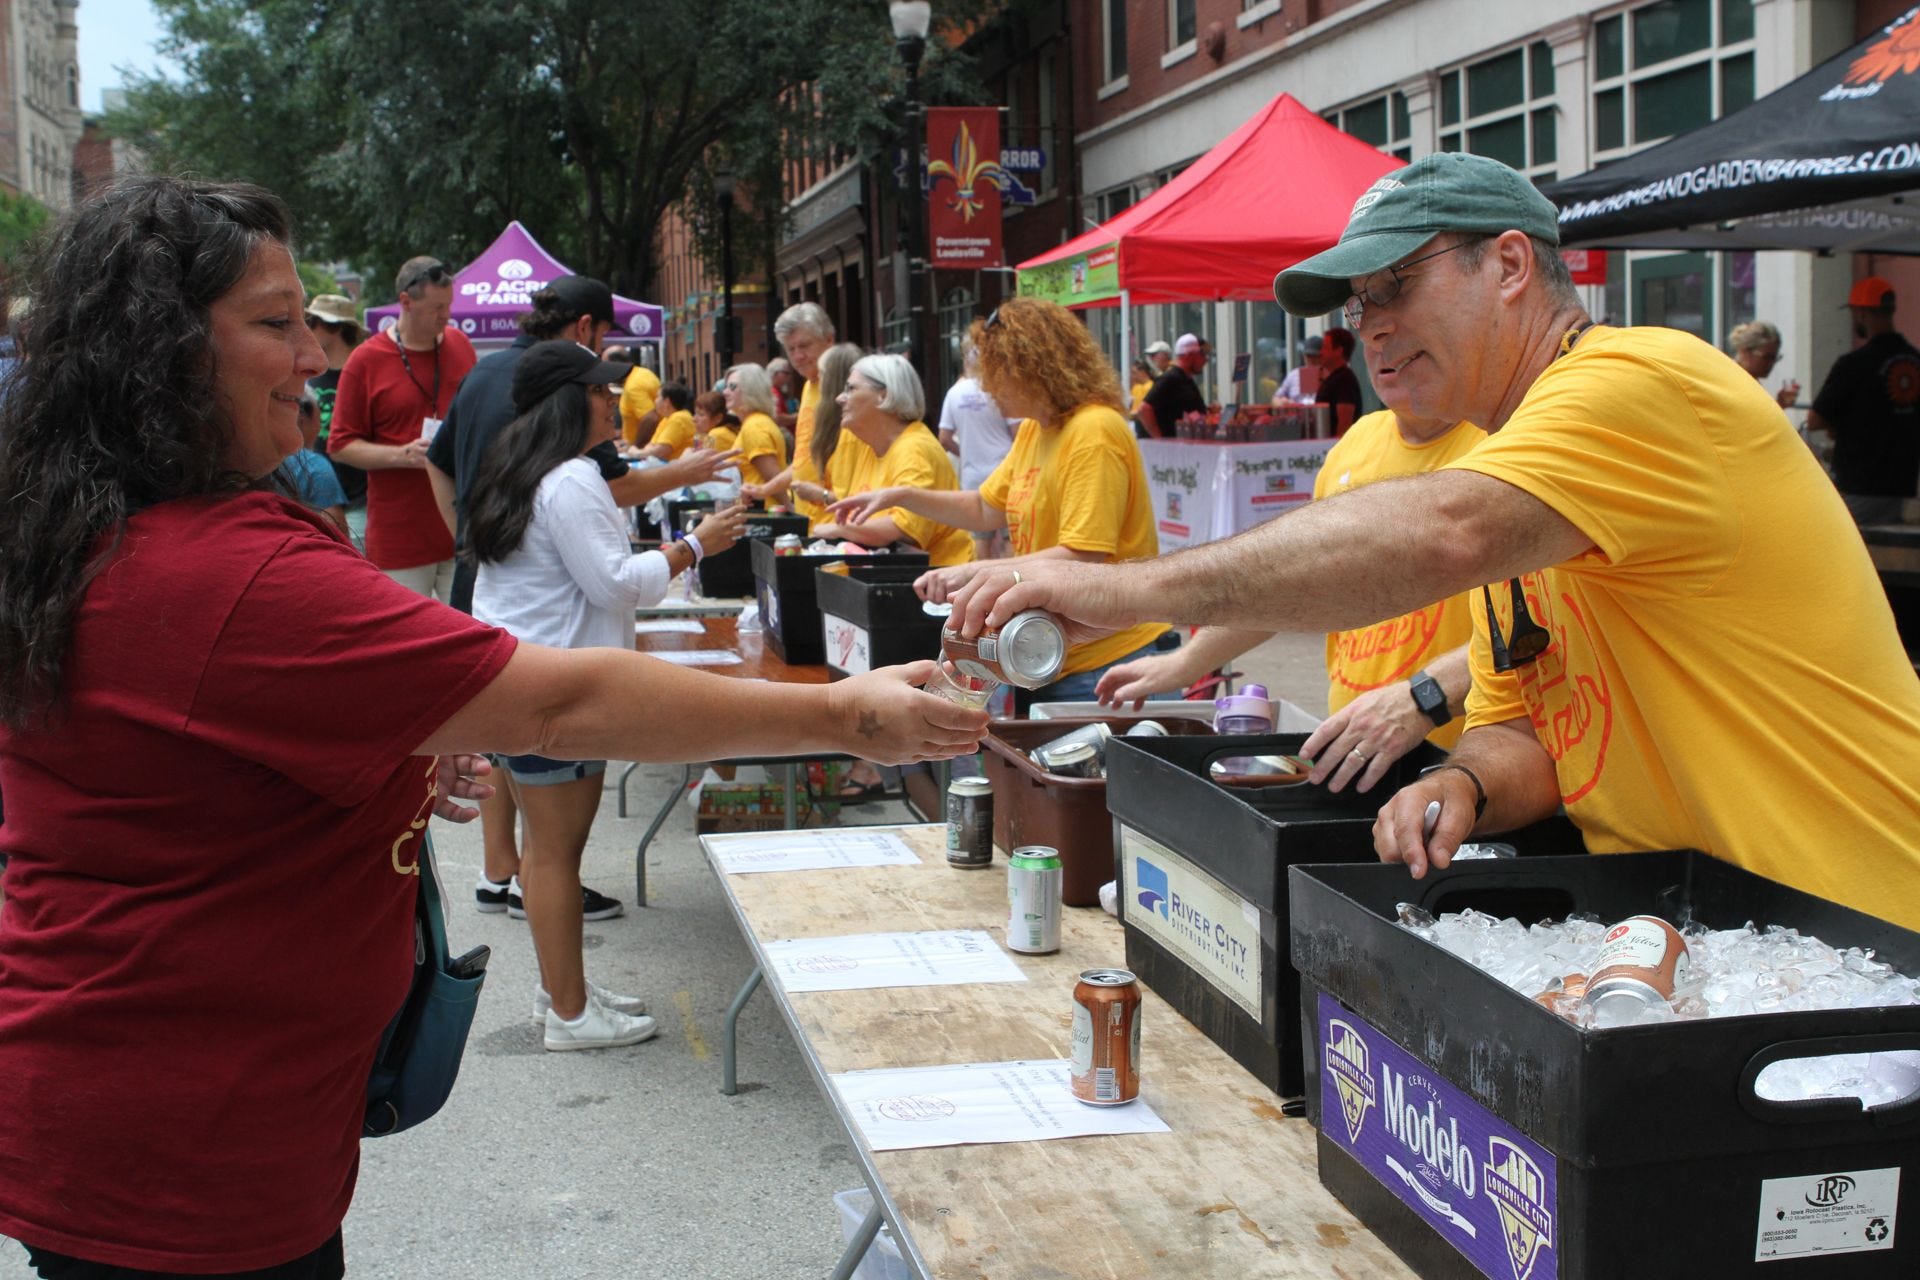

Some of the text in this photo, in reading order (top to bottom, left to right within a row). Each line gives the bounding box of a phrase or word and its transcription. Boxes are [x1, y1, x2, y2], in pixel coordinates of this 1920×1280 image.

[936, 237, 991, 247] Downtown
[936, 247, 985, 258] Louisville
[461, 282, 491, 296] 80
[1172, 892, 1247, 963] RIVER CITY
[1329, 1052, 1373, 1096] LOUISVILLE CITY
[1408, 1074, 1442, 1109] CERVEZA
[1382, 1062, 1476, 1199] Modelo
[1487, 1174, 1548, 1234] LOUISVILLE CITY
[1816, 1179, 1849, 1203] IRP
